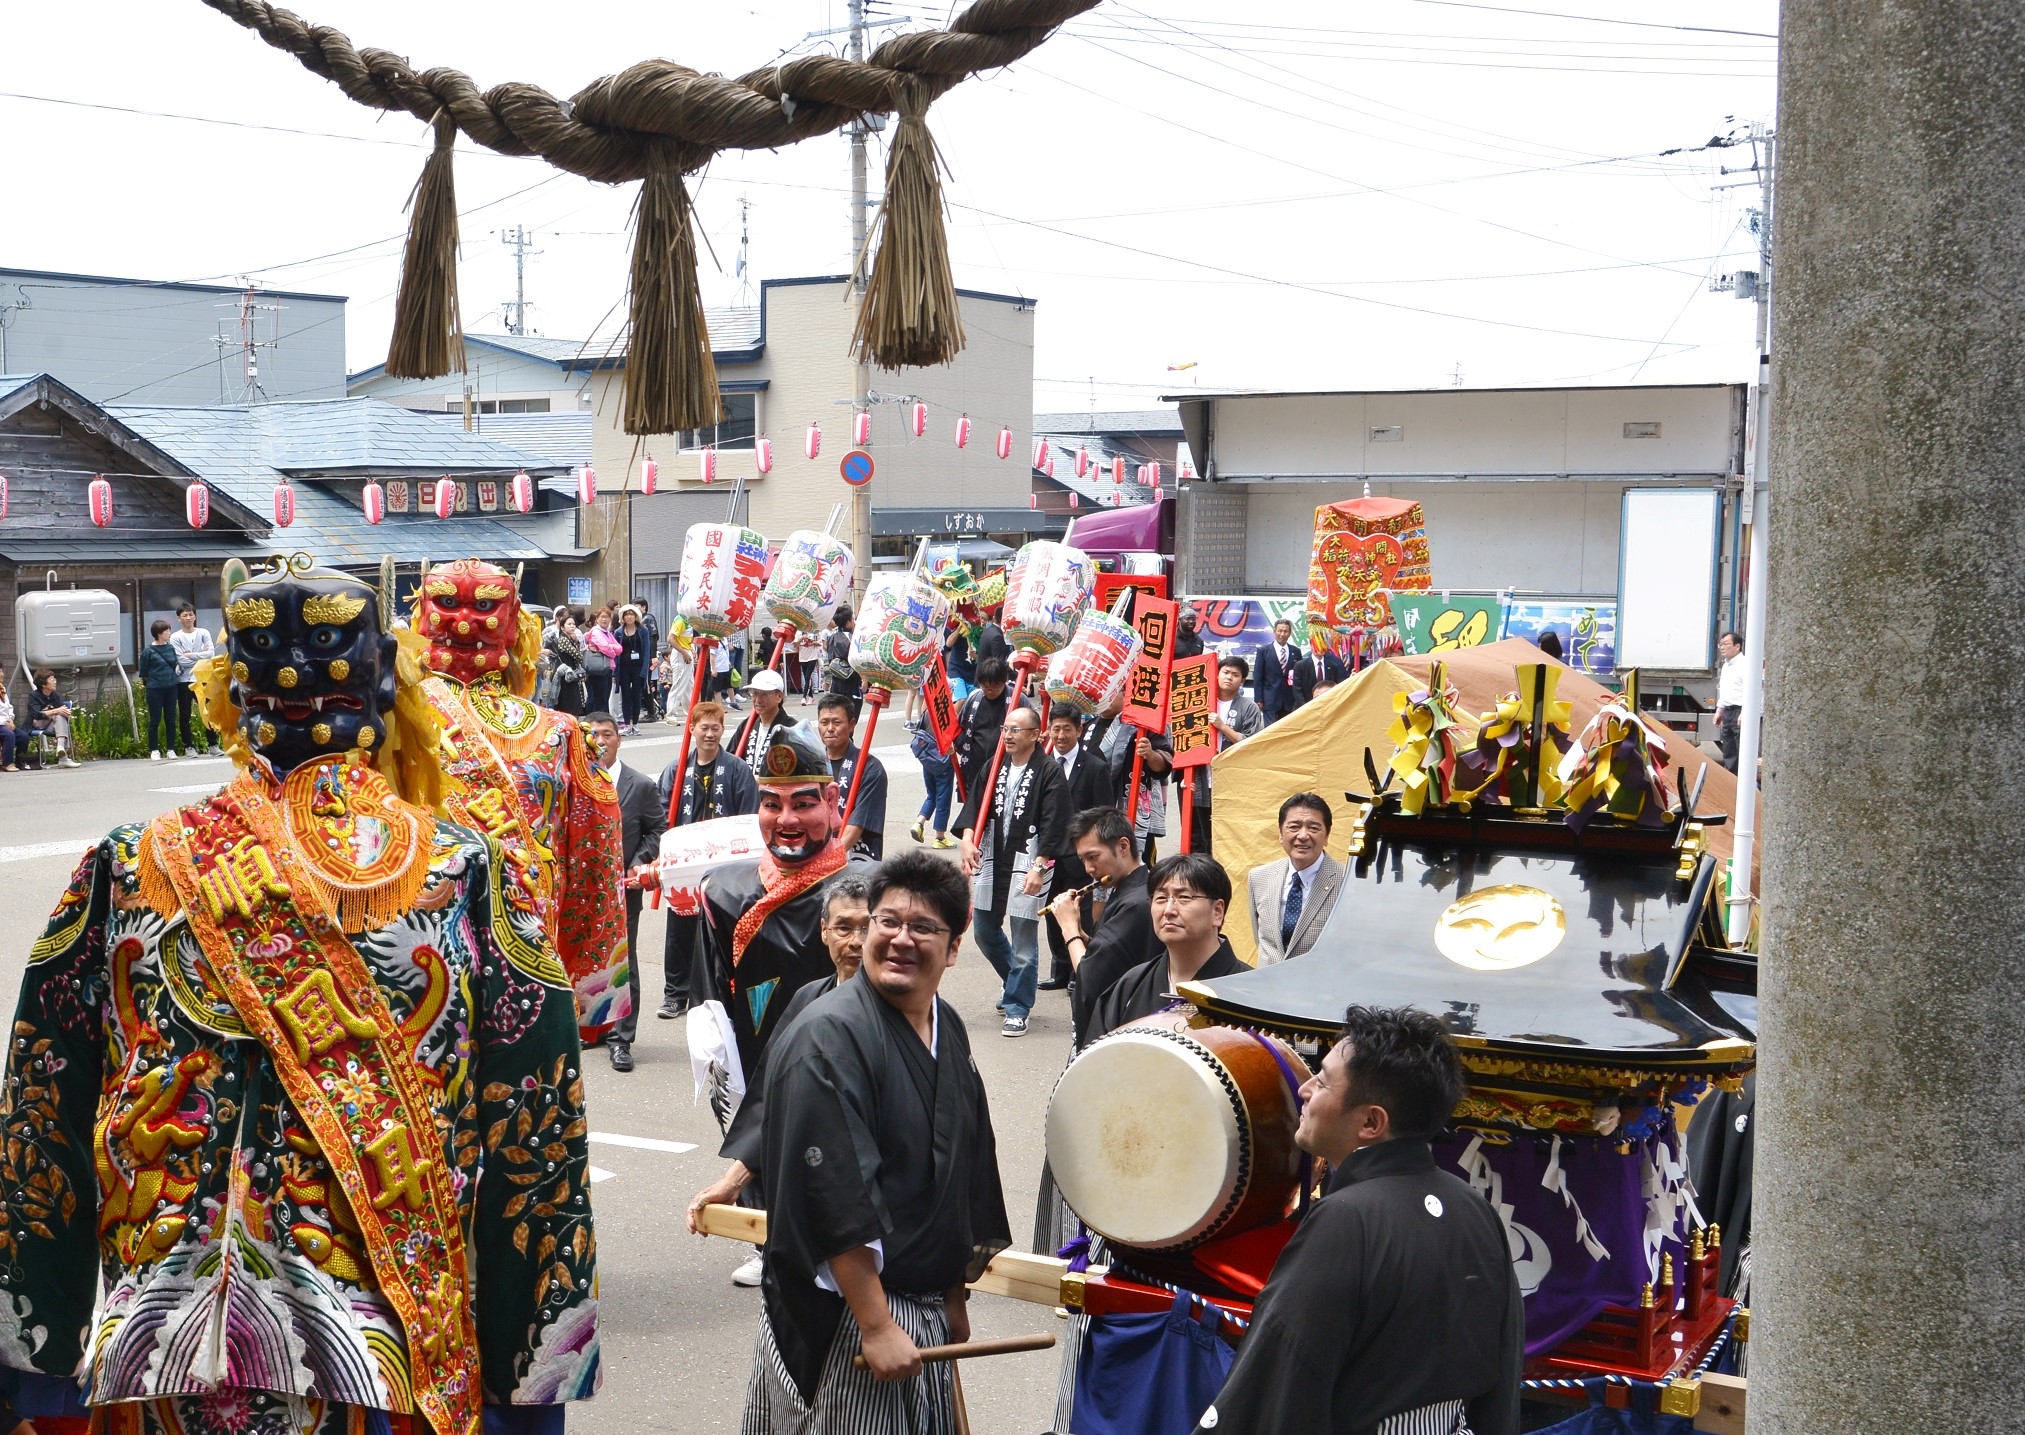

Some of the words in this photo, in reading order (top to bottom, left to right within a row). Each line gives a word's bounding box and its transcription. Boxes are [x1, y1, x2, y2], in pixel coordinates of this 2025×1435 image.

[945, 513, 985, 531] しずおか
[995, 765, 1008, 817] 大正山連中
[1013, 768, 1034, 820] 大正山連中
